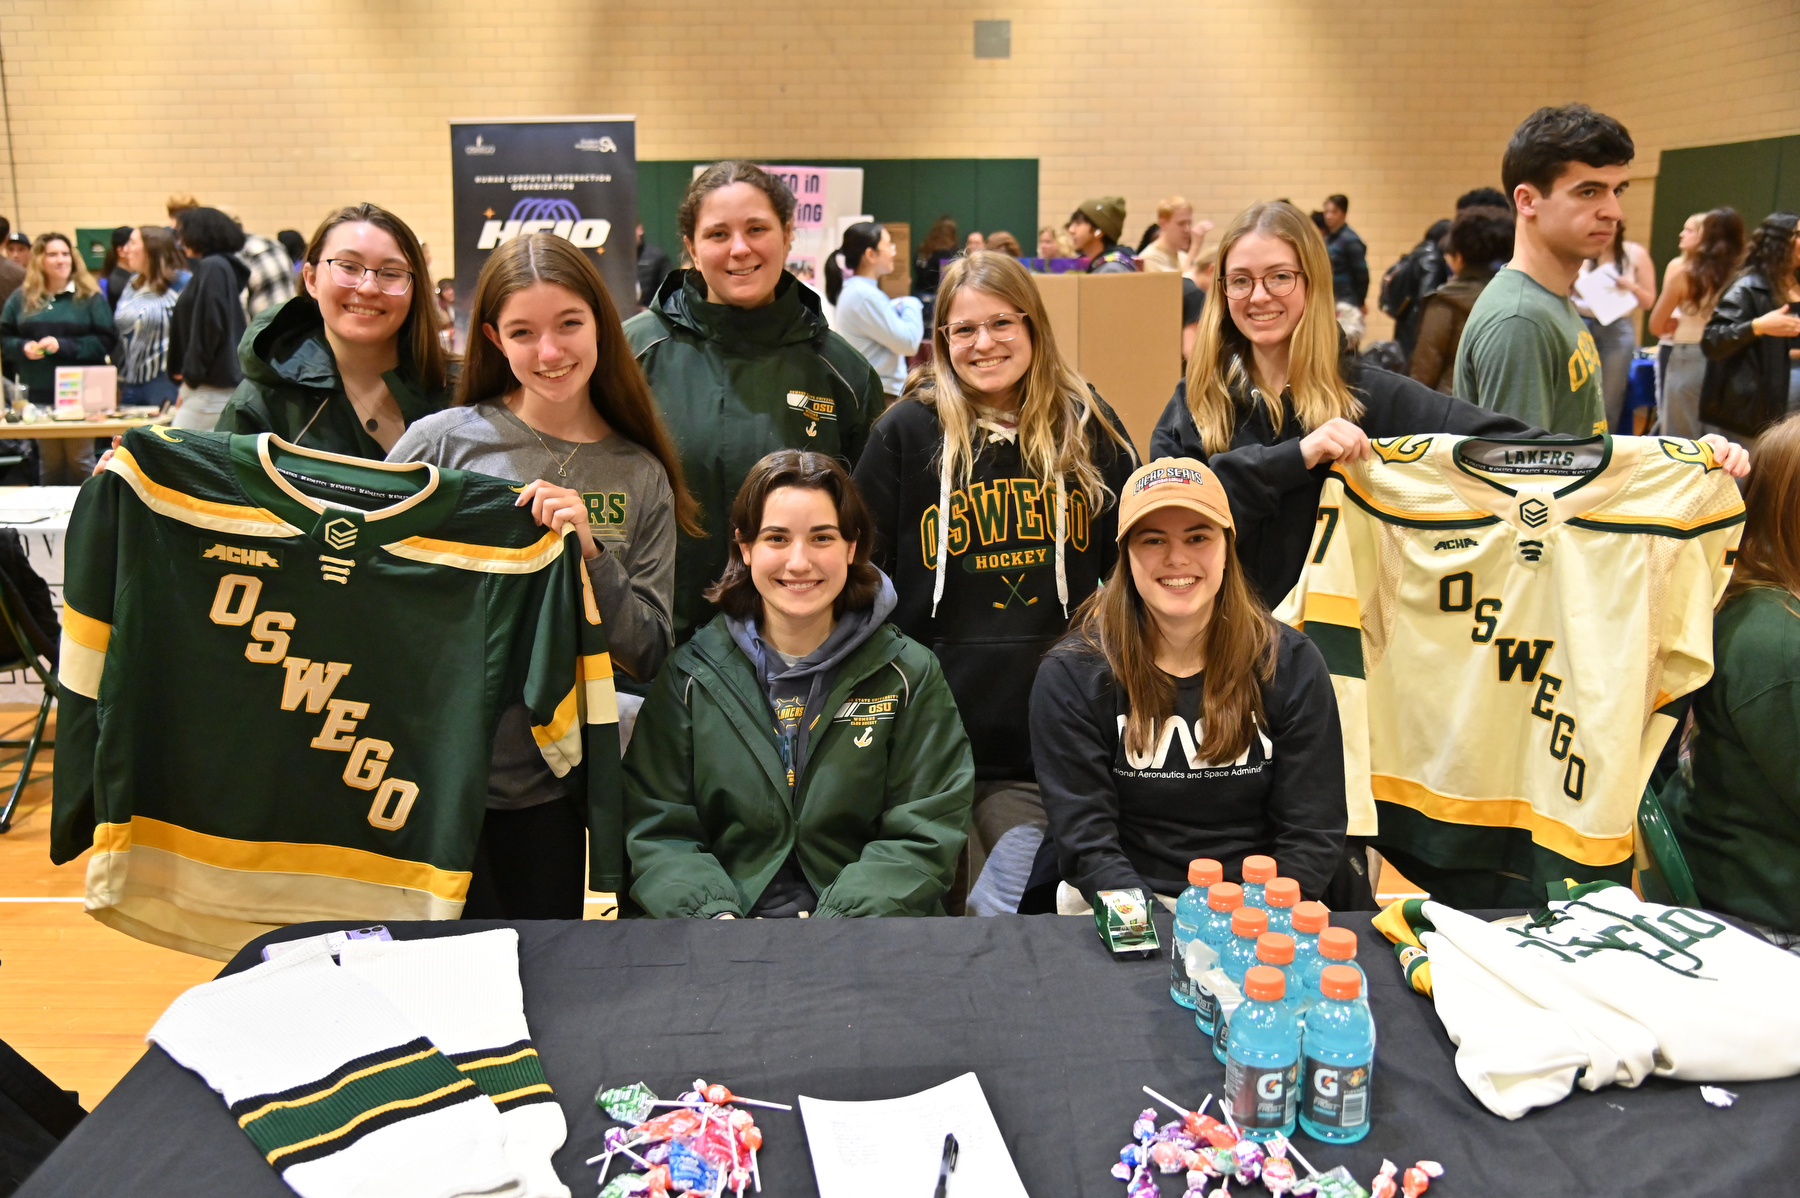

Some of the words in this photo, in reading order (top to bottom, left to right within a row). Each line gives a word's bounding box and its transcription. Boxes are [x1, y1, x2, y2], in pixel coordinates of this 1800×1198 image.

[474, 175, 505, 184] HUMAN
[506, 175, 552, 183] COMPUTER
[553, 174, 611, 183] INTERACTION
[511, 183, 574, 191] ORGANIZATION
[813, 402, 834, 414] OSU
[1504, 450, 1575, 467] LAKERS
[1133, 468, 1165, 496] CHEAP
[1166, 467, 1203, 486] SEATS
[920, 478, 1089, 570] OSWEGO
[1310, 505, 1342, 566] 7
[202, 543, 280, 568] ACHA
[1433, 537, 1479, 551] ACHA
[975, 548, 1047, 570] HOCKEY
[1438, 570, 1587, 802] OSWEGO
[208, 573, 420, 832] OSWEGO
[868, 702, 892, 714] OSU
[1113, 767, 1136, 778] tional
[1137, 770, 1185, 780] Aeronautics
[1187, 771, 1202, 780] and
[1204, 769, 1229, 779] Space
[1257, 1072, 1283, 1100] G
[1314, 1068, 1339, 1097] G
